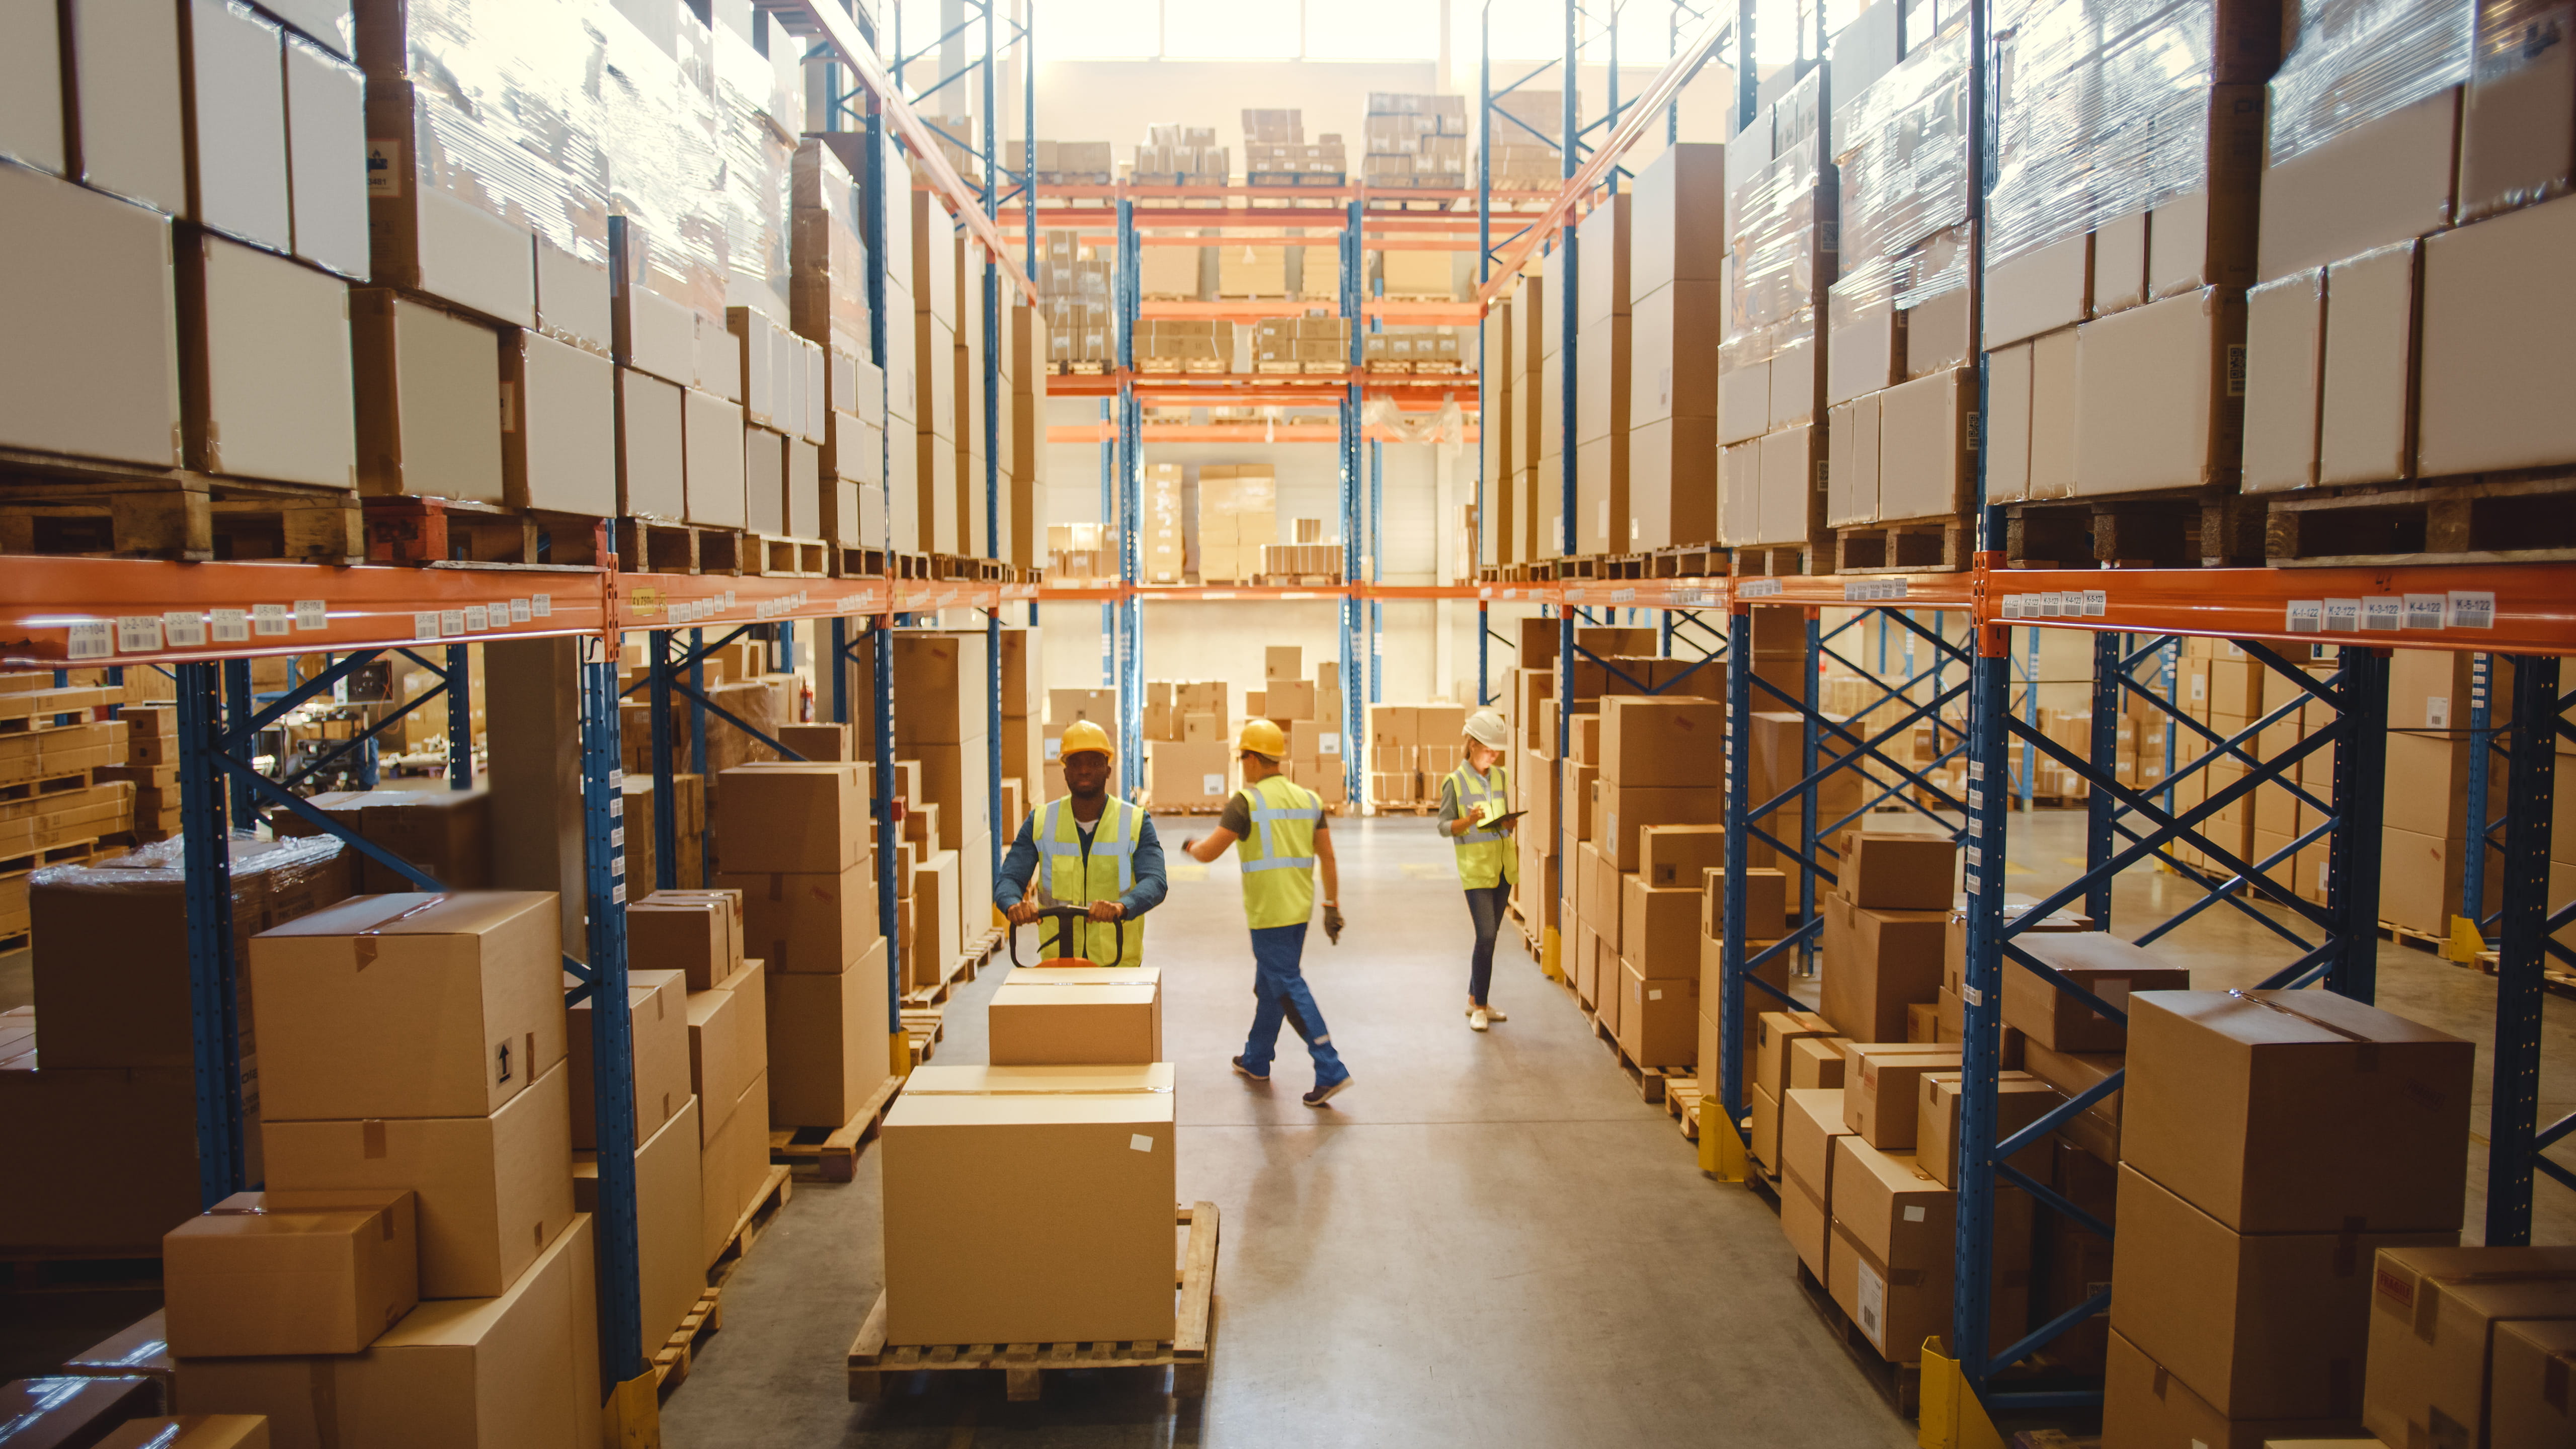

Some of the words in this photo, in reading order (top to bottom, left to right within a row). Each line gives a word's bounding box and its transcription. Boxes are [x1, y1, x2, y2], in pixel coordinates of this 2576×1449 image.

[2369, 604, 2399, 614] K-3-122
[2409, 603, 2441, 612] K-4-122
[2456, 599, 2490, 611] K-5-122
[2293, 608, 2318, 617] K-1-122
[2328, 606, 2356, 616] K-2-122
[123, 618, 155, 629] J-2-104
[170, 614, 199, 625] J-3-104
[72, 624, 106, 635] J-1-104
